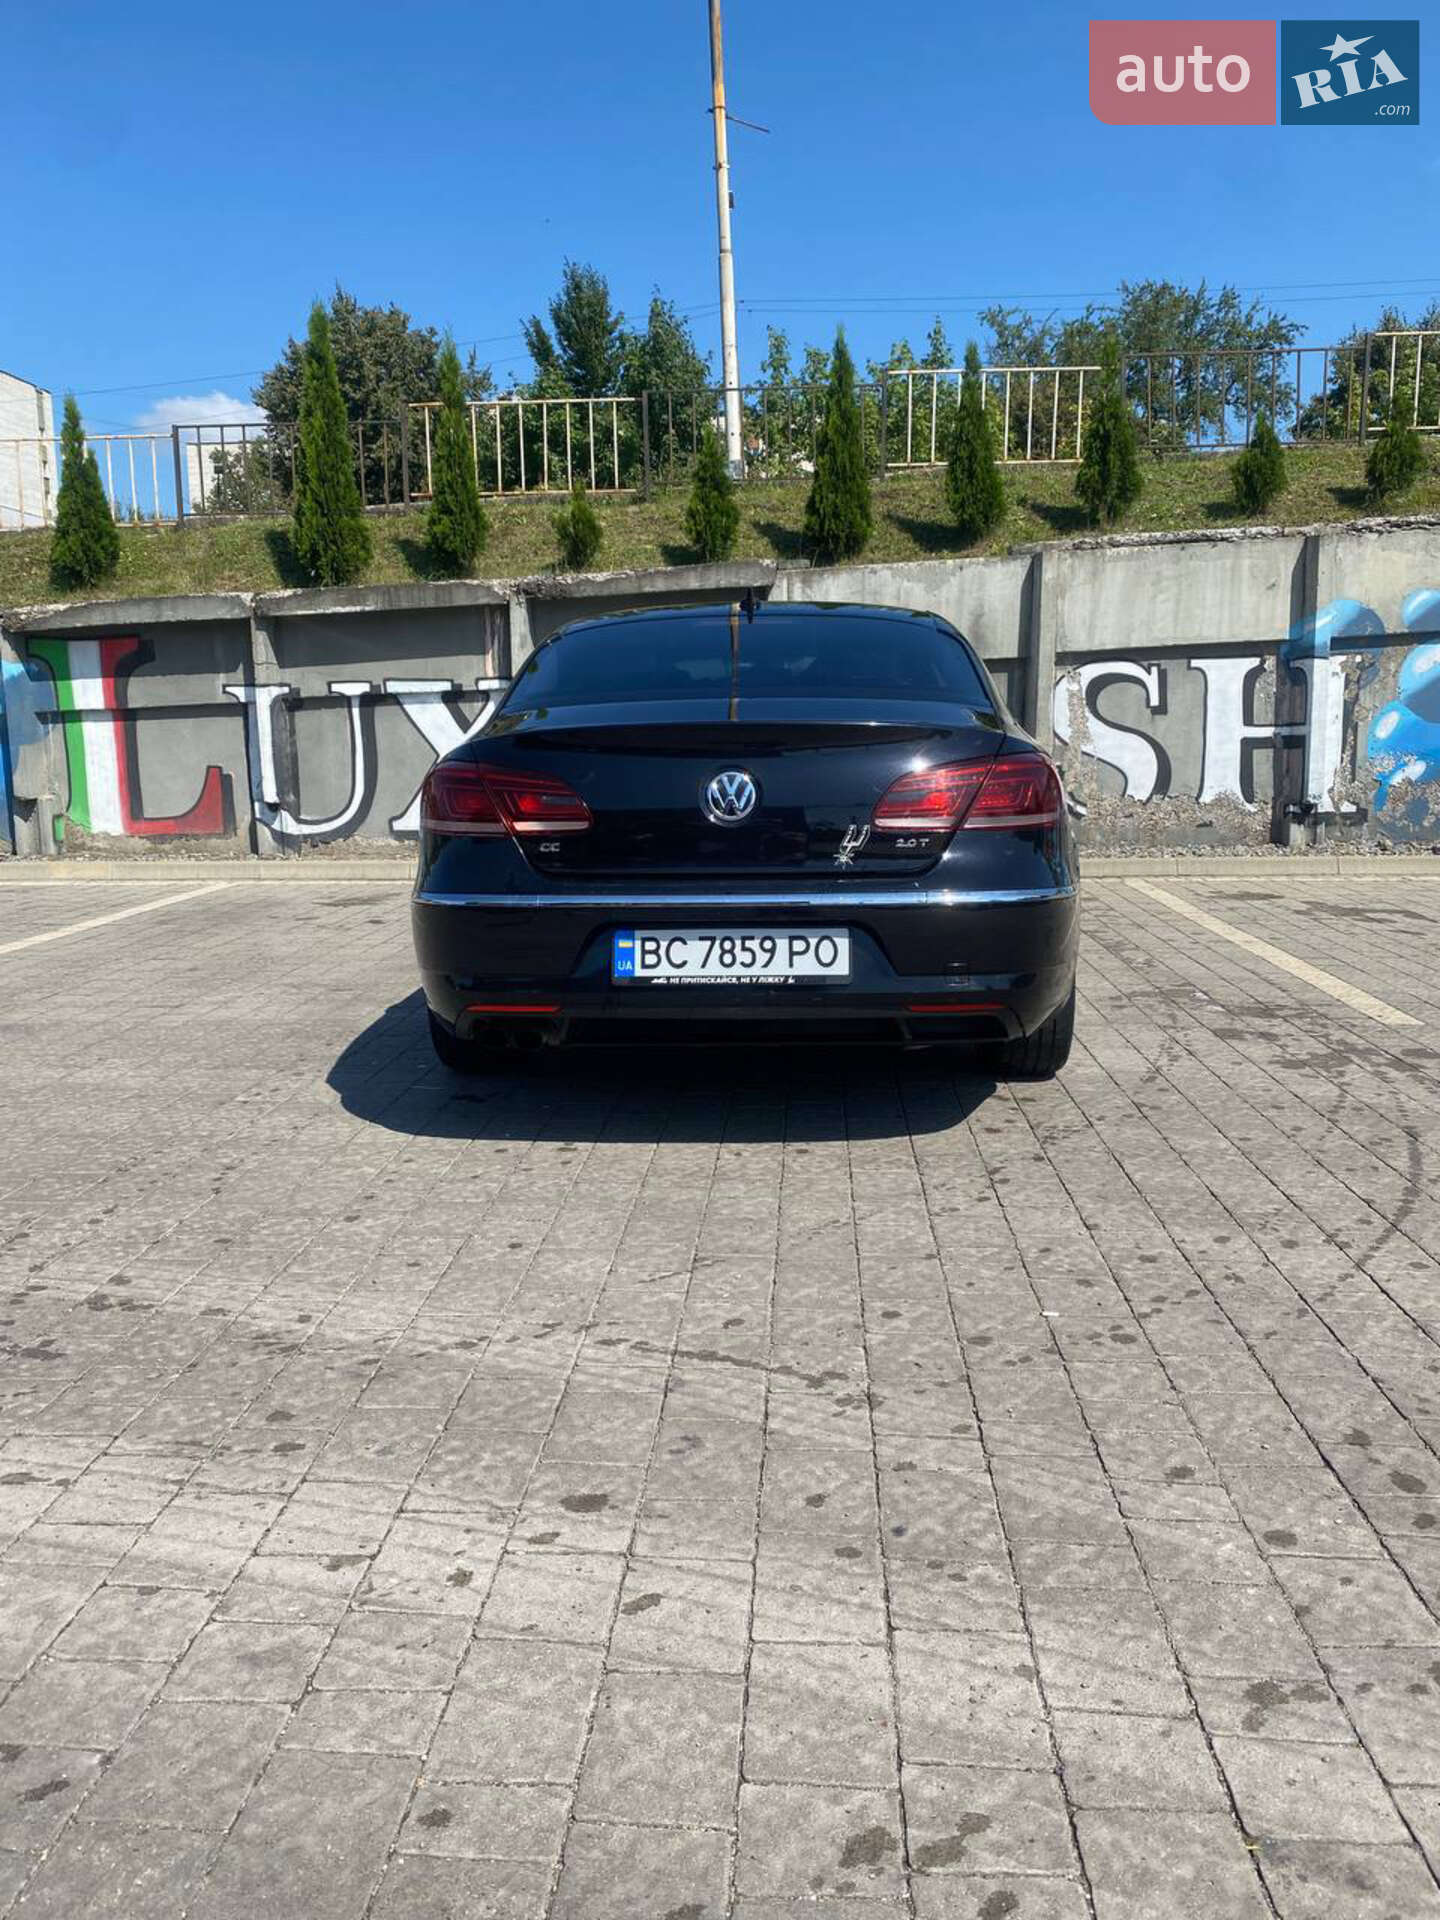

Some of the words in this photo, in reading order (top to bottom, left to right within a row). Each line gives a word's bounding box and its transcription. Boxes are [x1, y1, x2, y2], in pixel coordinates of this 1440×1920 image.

[540, 842, 560, 852] CC
[640, 936, 688, 969] BC
[698, 935, 777, 969] 7859
[788, 935, 838, 968] PO
[617, 960, 633, 970] UA
